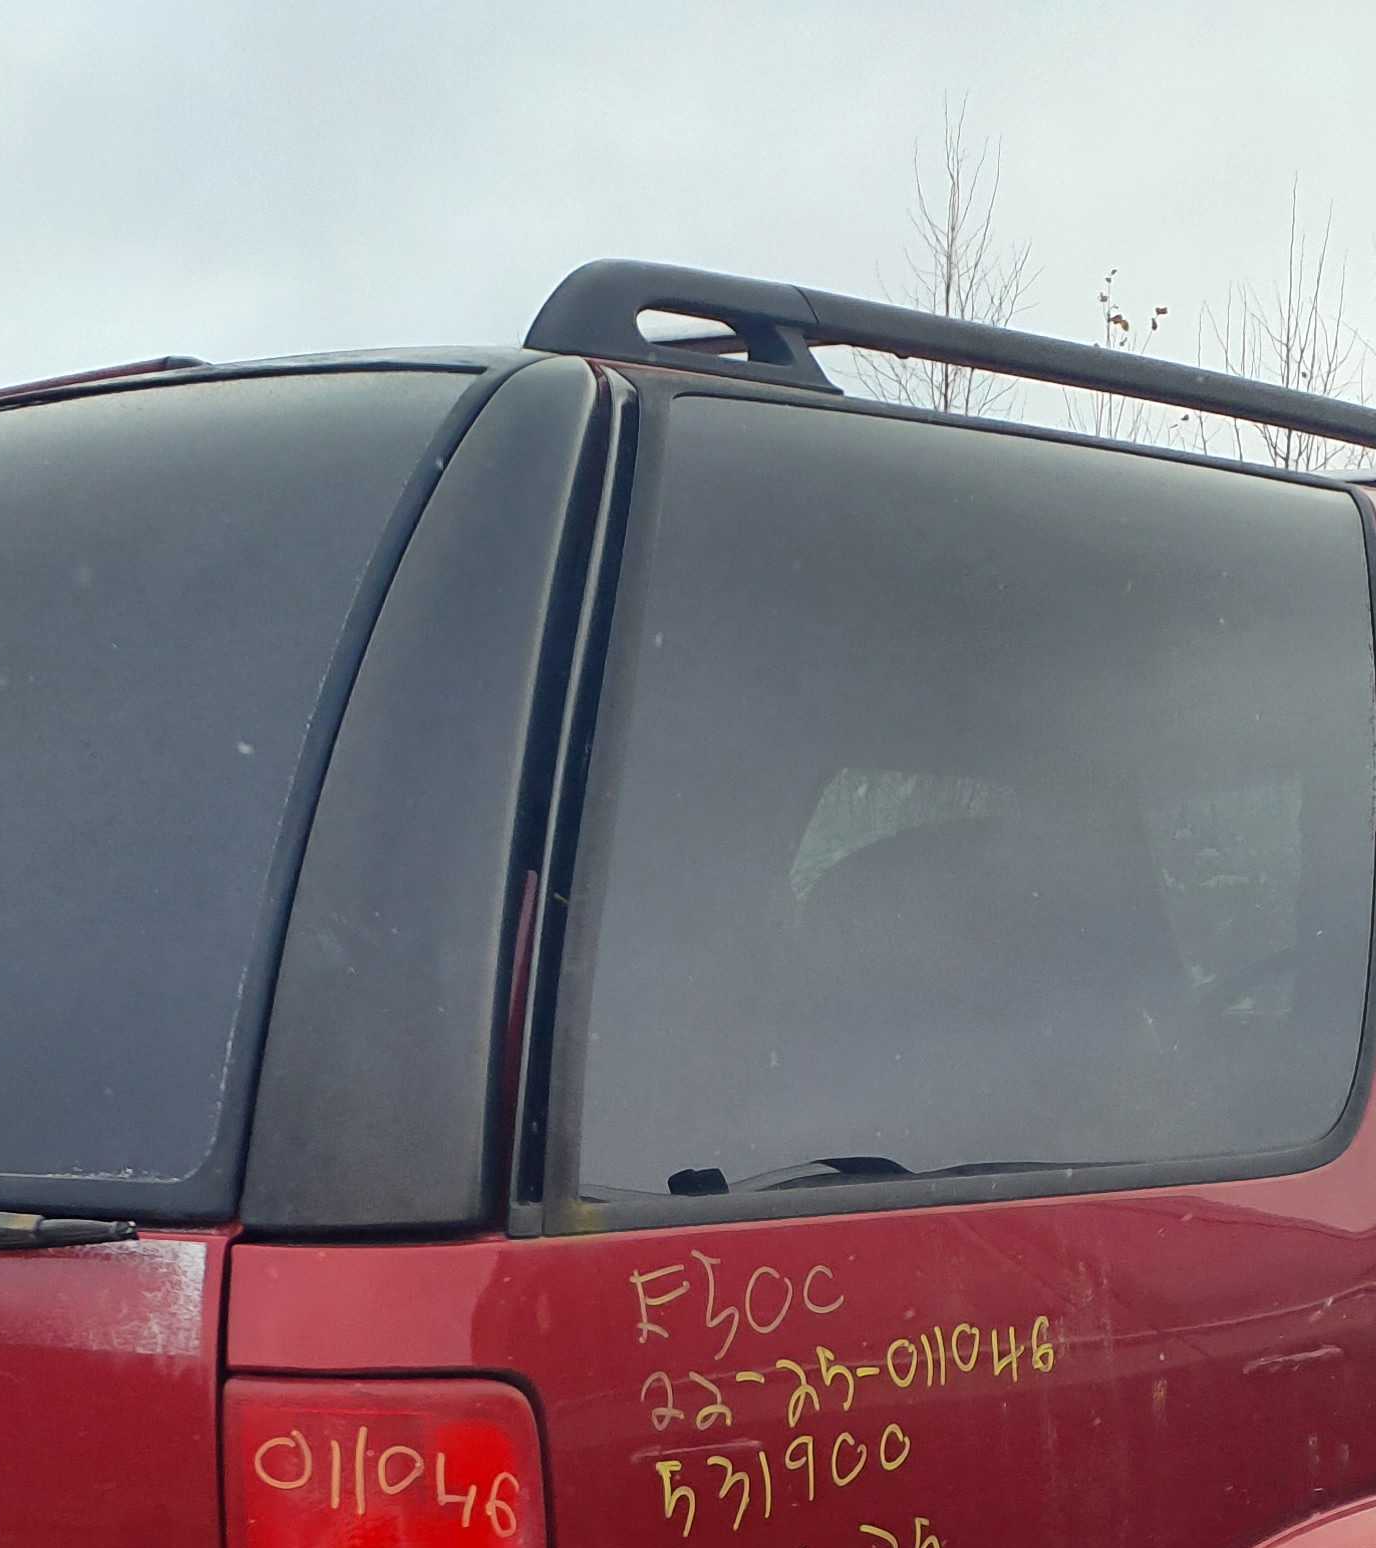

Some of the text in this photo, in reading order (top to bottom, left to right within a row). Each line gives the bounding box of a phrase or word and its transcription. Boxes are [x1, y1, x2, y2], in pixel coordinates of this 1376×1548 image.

[640, 1315, 1055, 1431] 22-25-011046
[254, 1425, 520, 1538] 011046
[655, 1423, 910, 1538] 531900
